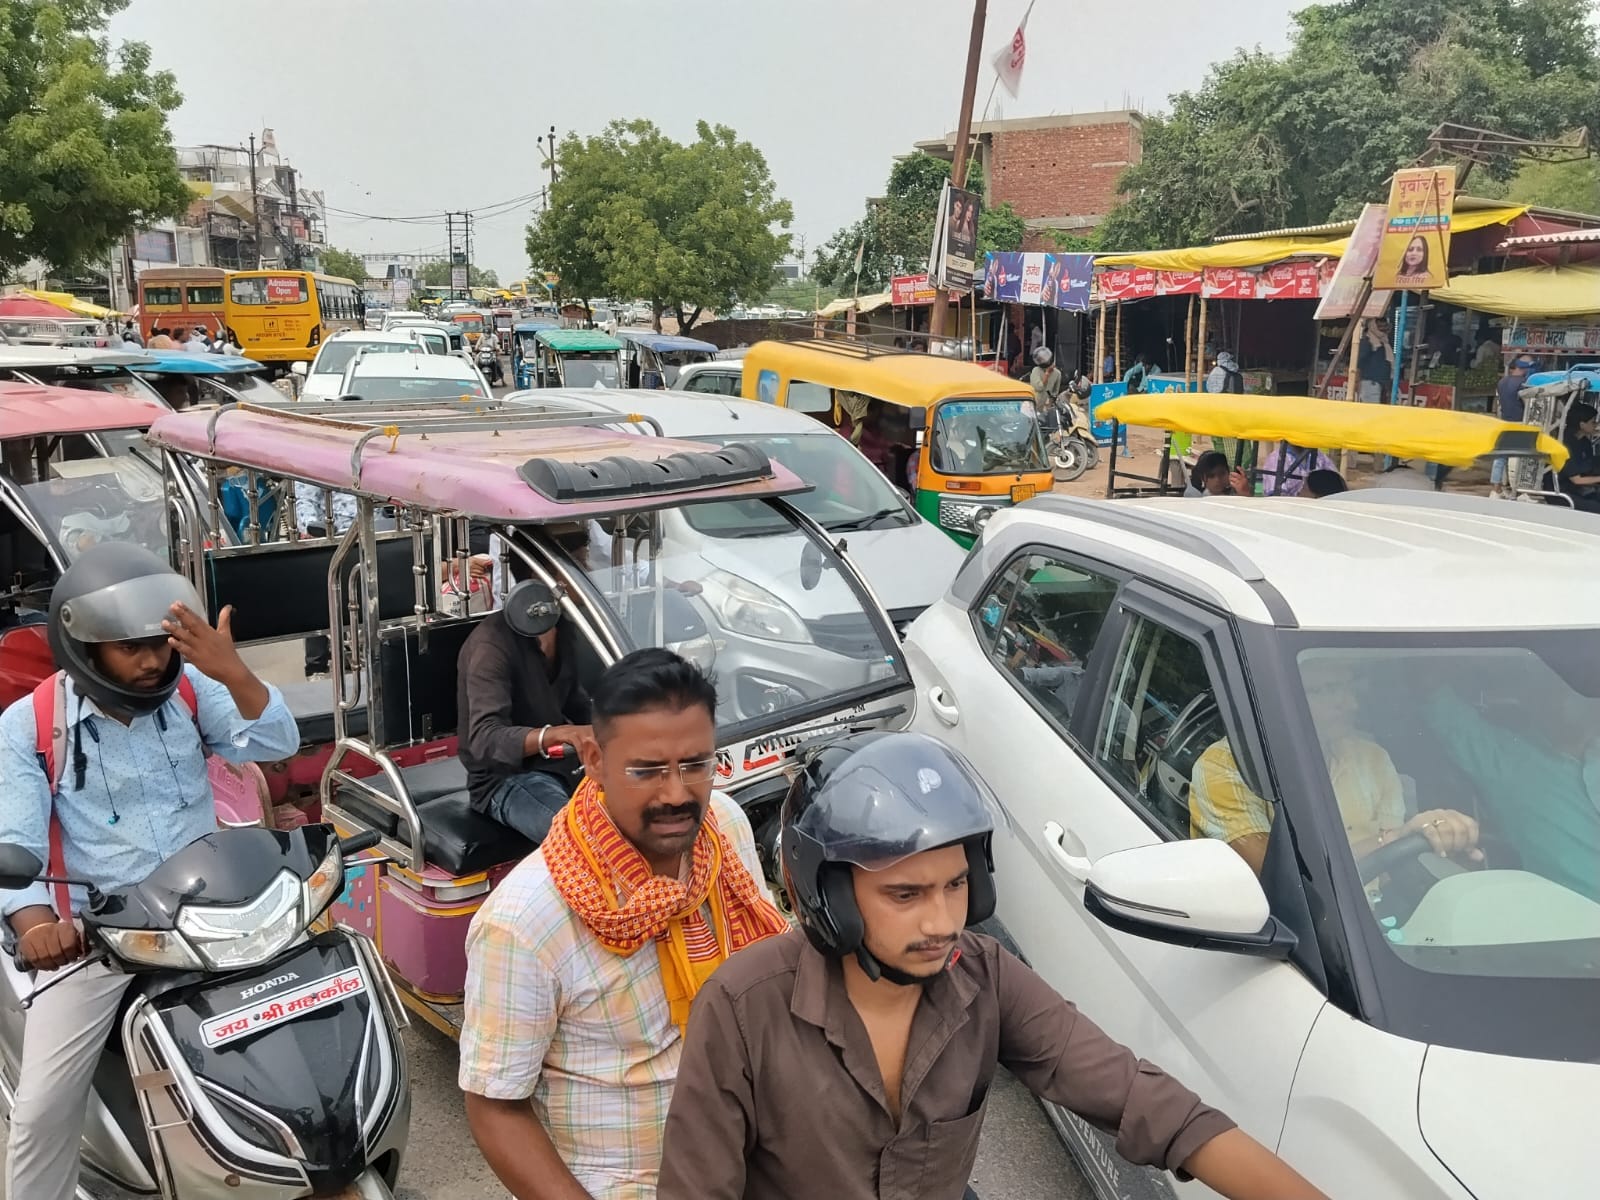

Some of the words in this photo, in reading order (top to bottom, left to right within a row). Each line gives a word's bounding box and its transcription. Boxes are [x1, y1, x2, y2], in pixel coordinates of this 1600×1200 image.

[268, 279, 299, 287] Admission
[275, 287, 291, 296] Open
[239, 972, 300, 1000] HONDA
[213, 1018, 249, 1038] जय
[261, 1004, 285, 1021] श्री
